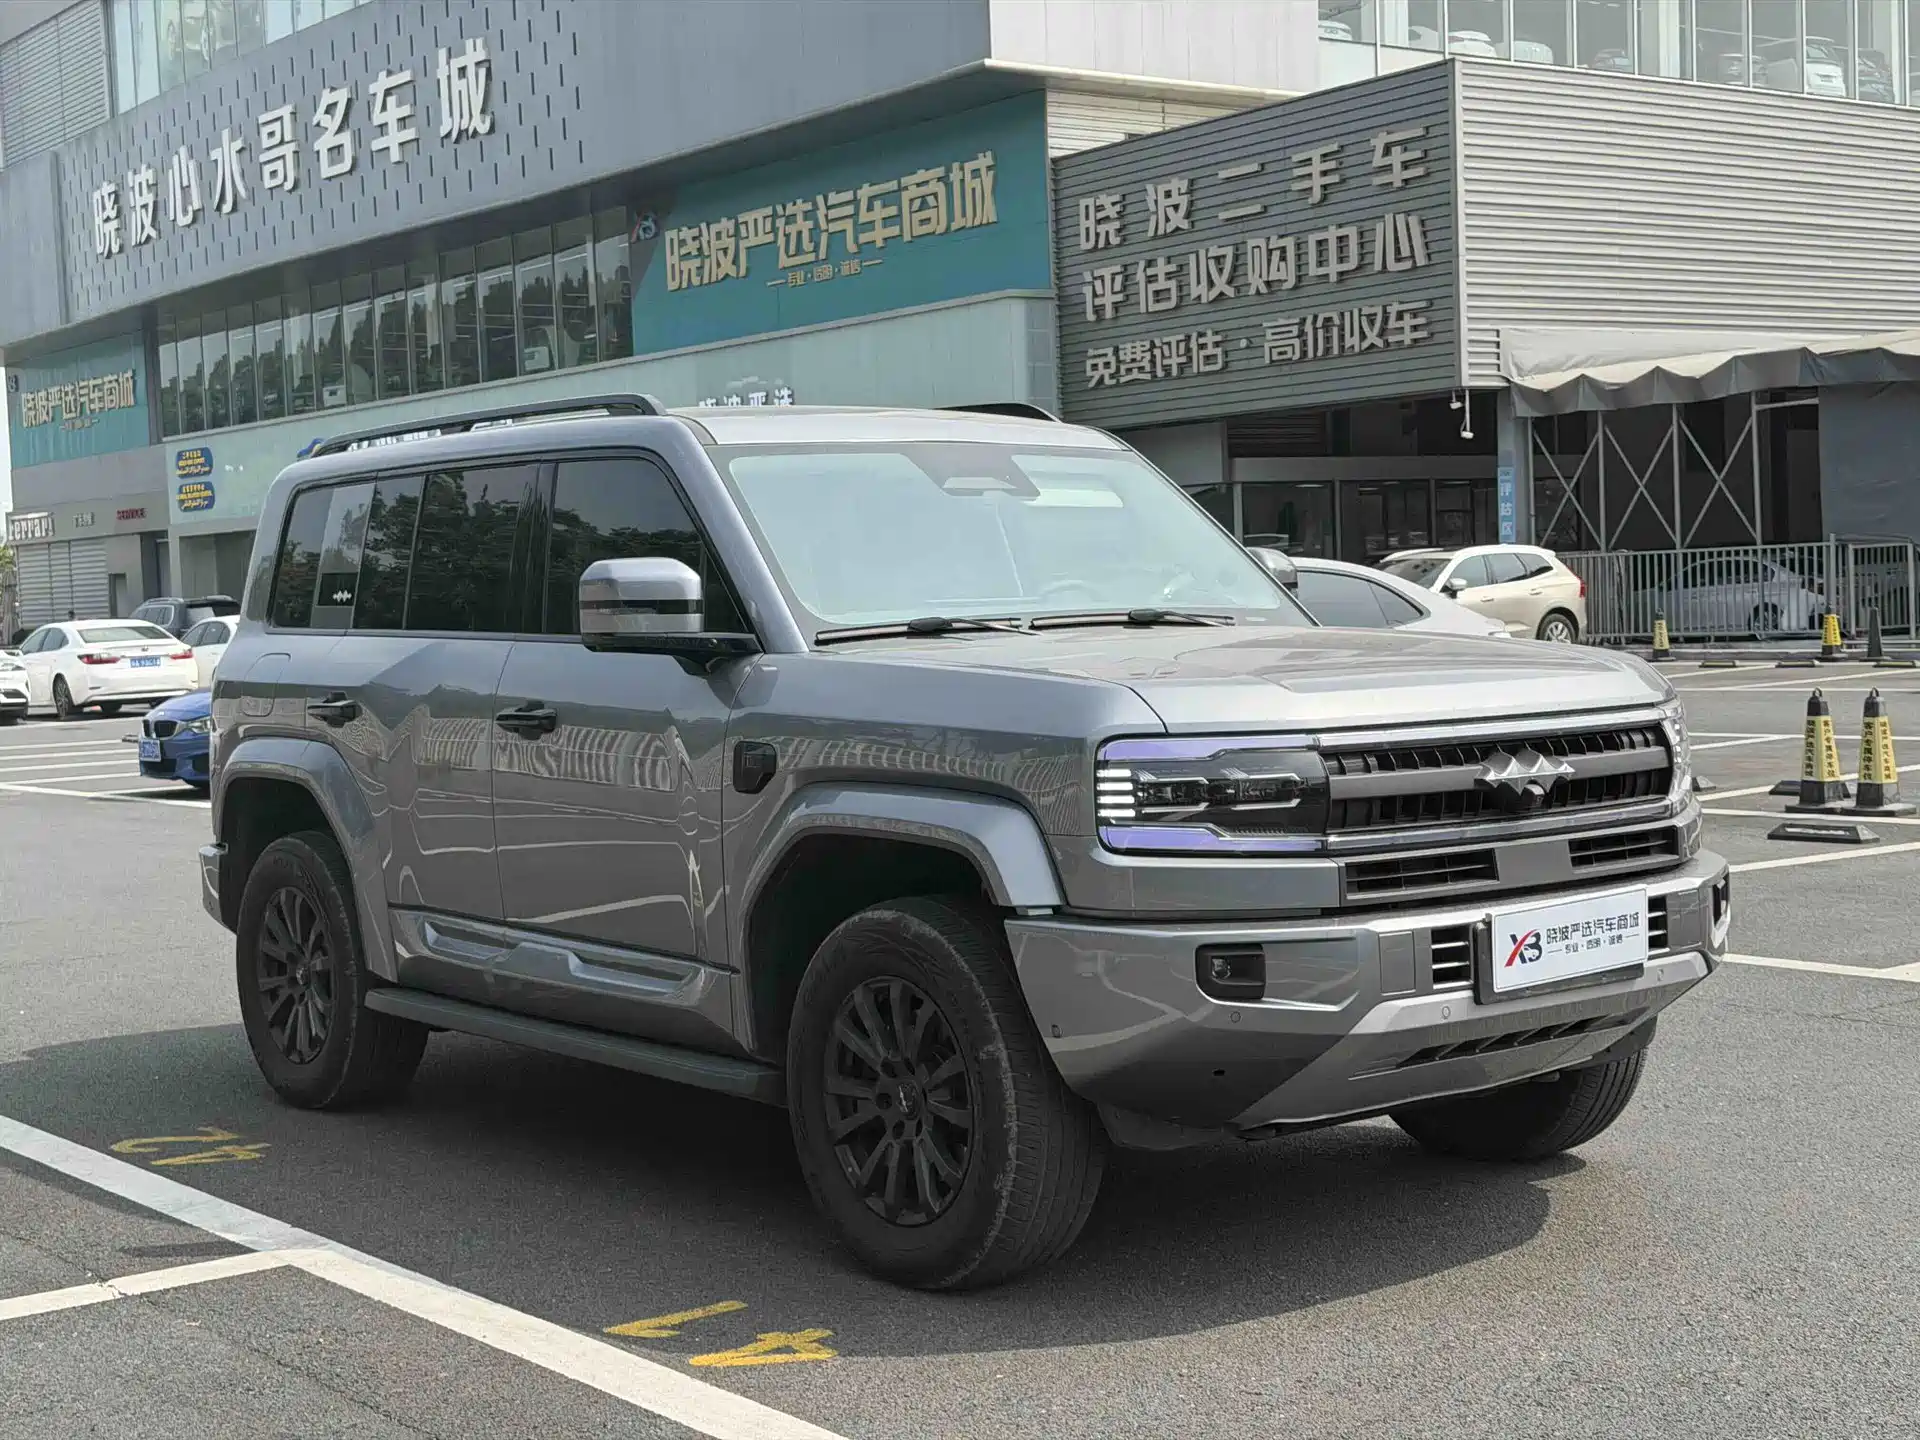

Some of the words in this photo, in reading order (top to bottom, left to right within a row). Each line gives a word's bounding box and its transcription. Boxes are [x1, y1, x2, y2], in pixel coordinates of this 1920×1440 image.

[93, 37, 496, 259] 晓波心水哥名车城
[1079, 126, 1429, 250] 晓波二手车
[664, 150, 998, 292] 晓波严选汽车商城
[1082, 213, 1431, 321] 评估收购中心
[1085, 300, 1432, 388] 免费评估·高价收车
[1546, 911, 1640, 944] 晓波严选汽车商城
